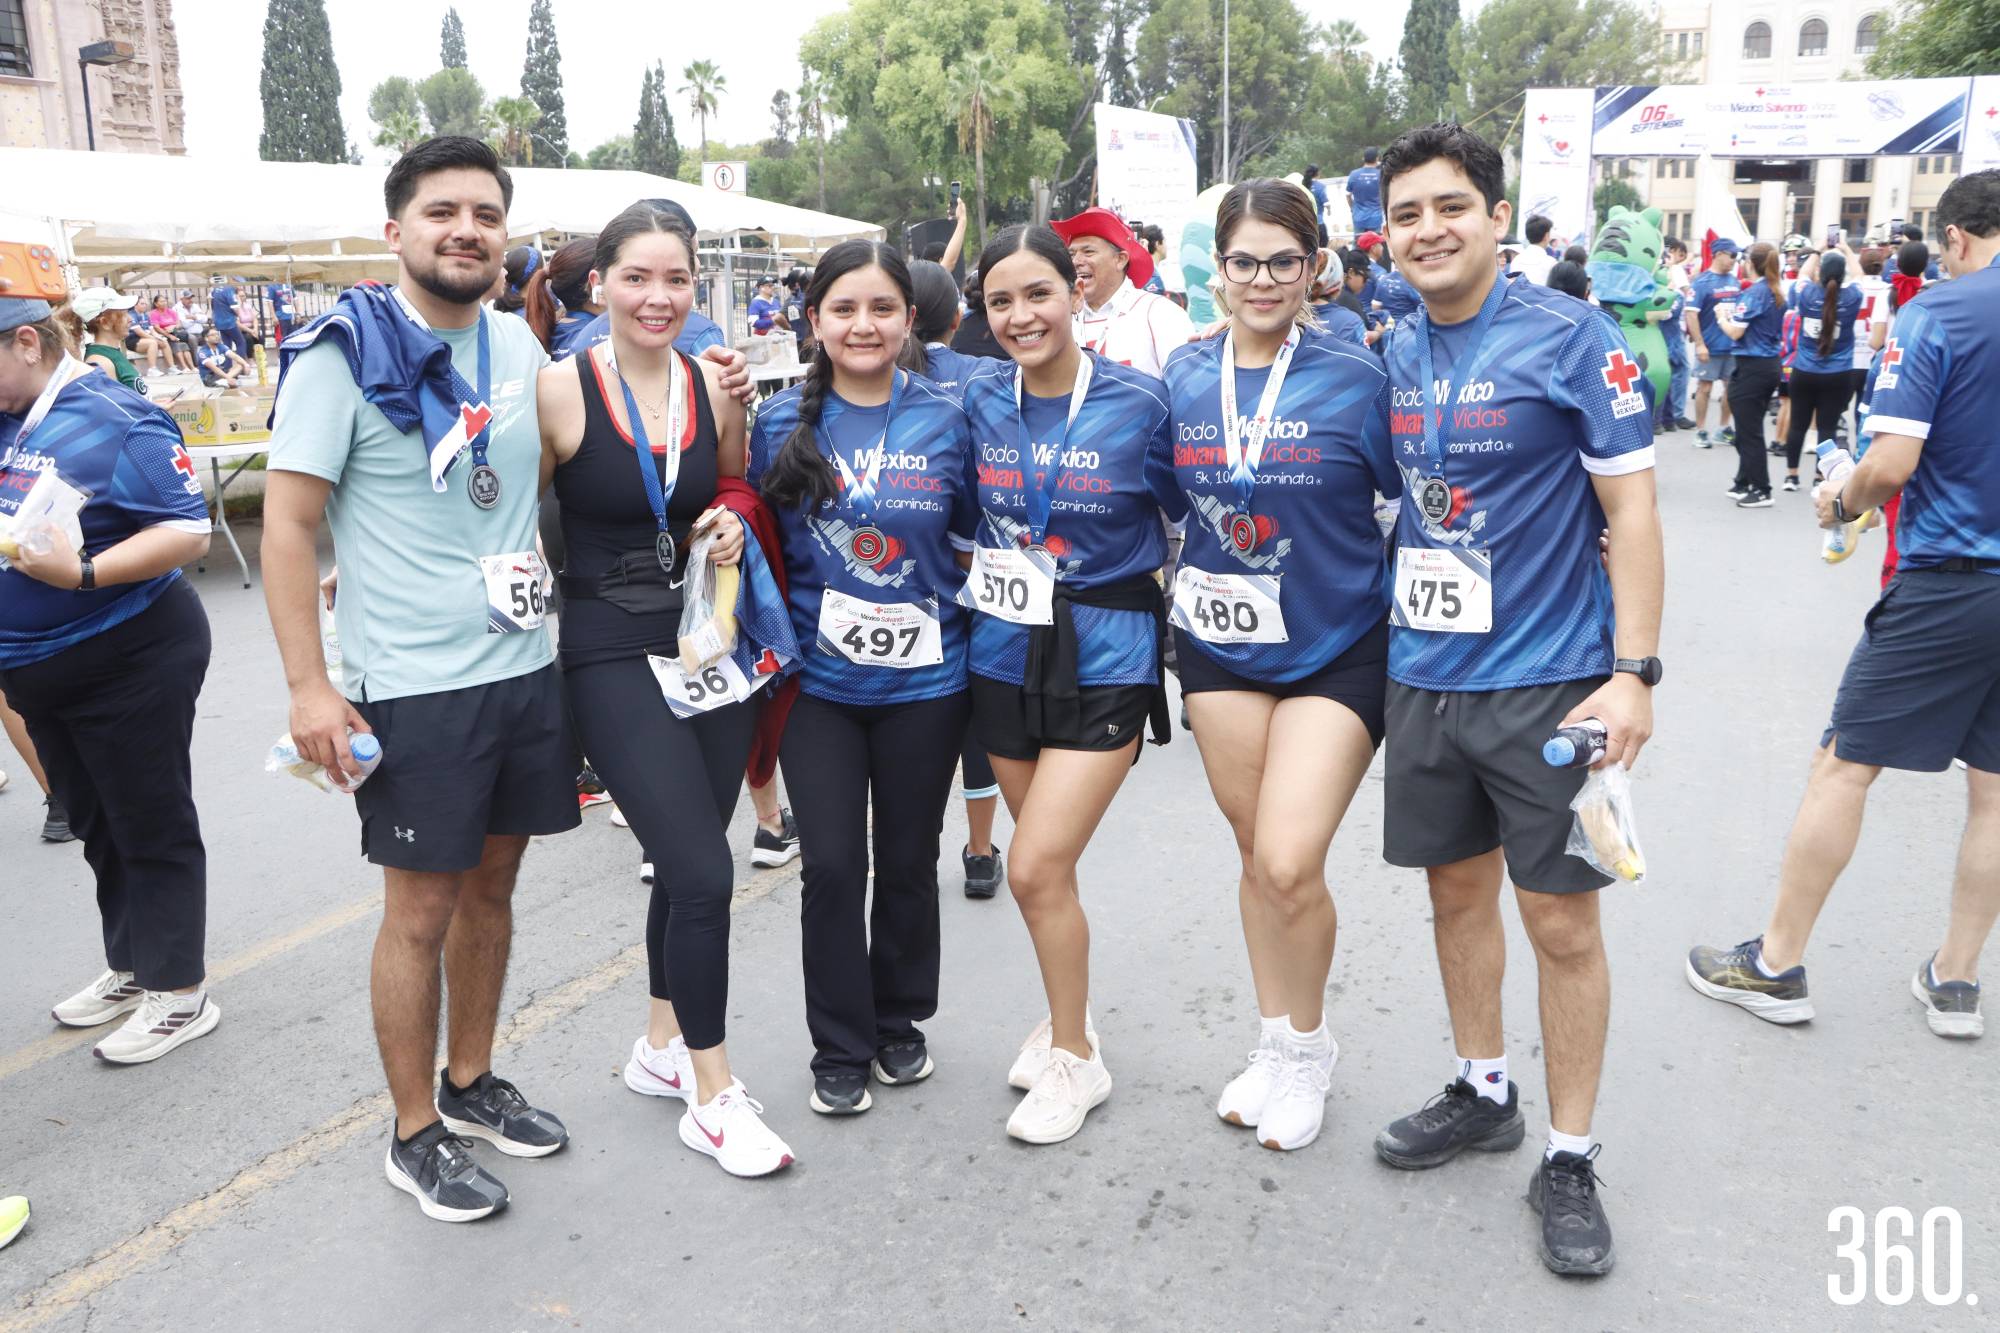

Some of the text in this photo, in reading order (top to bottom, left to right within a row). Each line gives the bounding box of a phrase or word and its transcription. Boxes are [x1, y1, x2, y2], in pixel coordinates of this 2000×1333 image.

[1640, 105, 1668, 122] 06
[1730, 102, 1763, 113] México
[1765, 102, 1808, 112] Salvando
[1630, 119, 1685, 134] SEPTIEMBRE
[1433, 378, 1495, 405] Mxico
[173, 409, 197, 422] enia
[1454, 406, 1507, 428] Vidas
[1178, 421, 1218, 442] Todo
[982, 443, 1019, 464] Todo
[1260, 442, 1321, 464] Vidas
[1450, 438, 1503, 454] caminata
[854, 448, 927, 470] México
[886, 473, 943, 492] Vidas
[1056, 471, 1112, 494] Vidas
[1216, 471, 1231, 485] 10
[1255, 471, 1314, 485] caminata
[886, 498, 938, 512] caminata
[1051, 500, 1105, 514] caminata
[980, 572, 1029, 611] 570
[1409, 579, 1462, 619] 475
[1193, 596, 1259, 632] 480
[842, 624, 920, 657] 497
